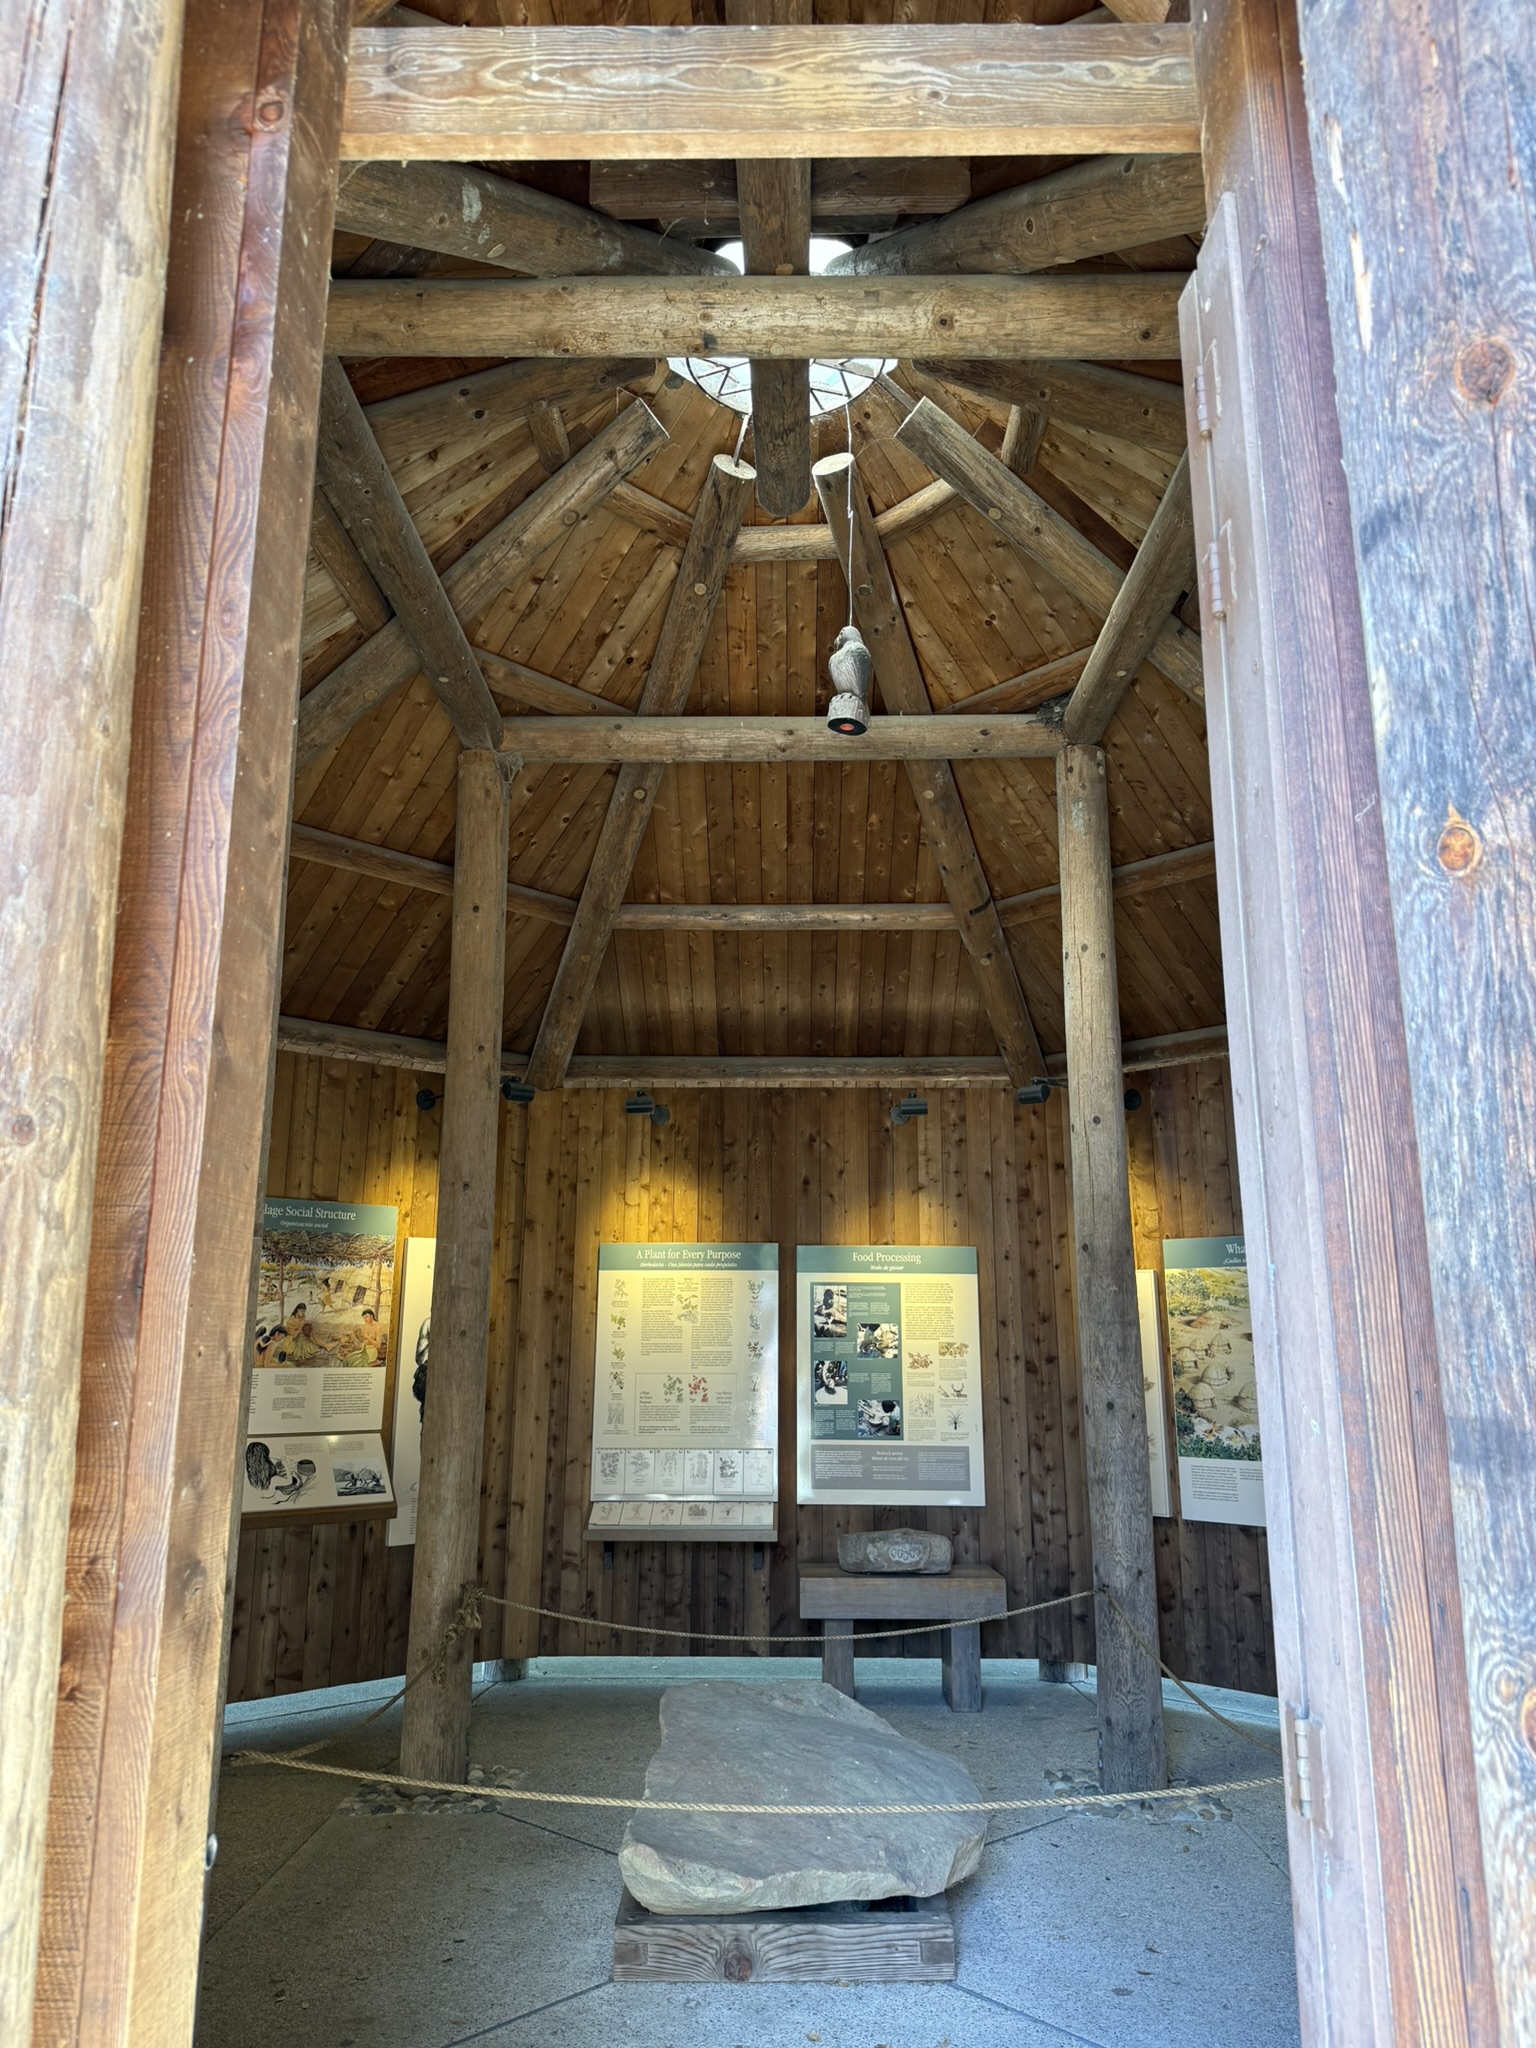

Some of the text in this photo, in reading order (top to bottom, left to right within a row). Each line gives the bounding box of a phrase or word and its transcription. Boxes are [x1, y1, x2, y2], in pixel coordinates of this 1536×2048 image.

[264, 1203, 356, 1221] lage Social Structure
[314, 1221, 330, 1229] social
[636, 1248, 741, 1261] A Plant for Every Purpose
[1225, 1243, 1246, 1254] Wha
[852, 1252, 922, 1264] Food Processing
